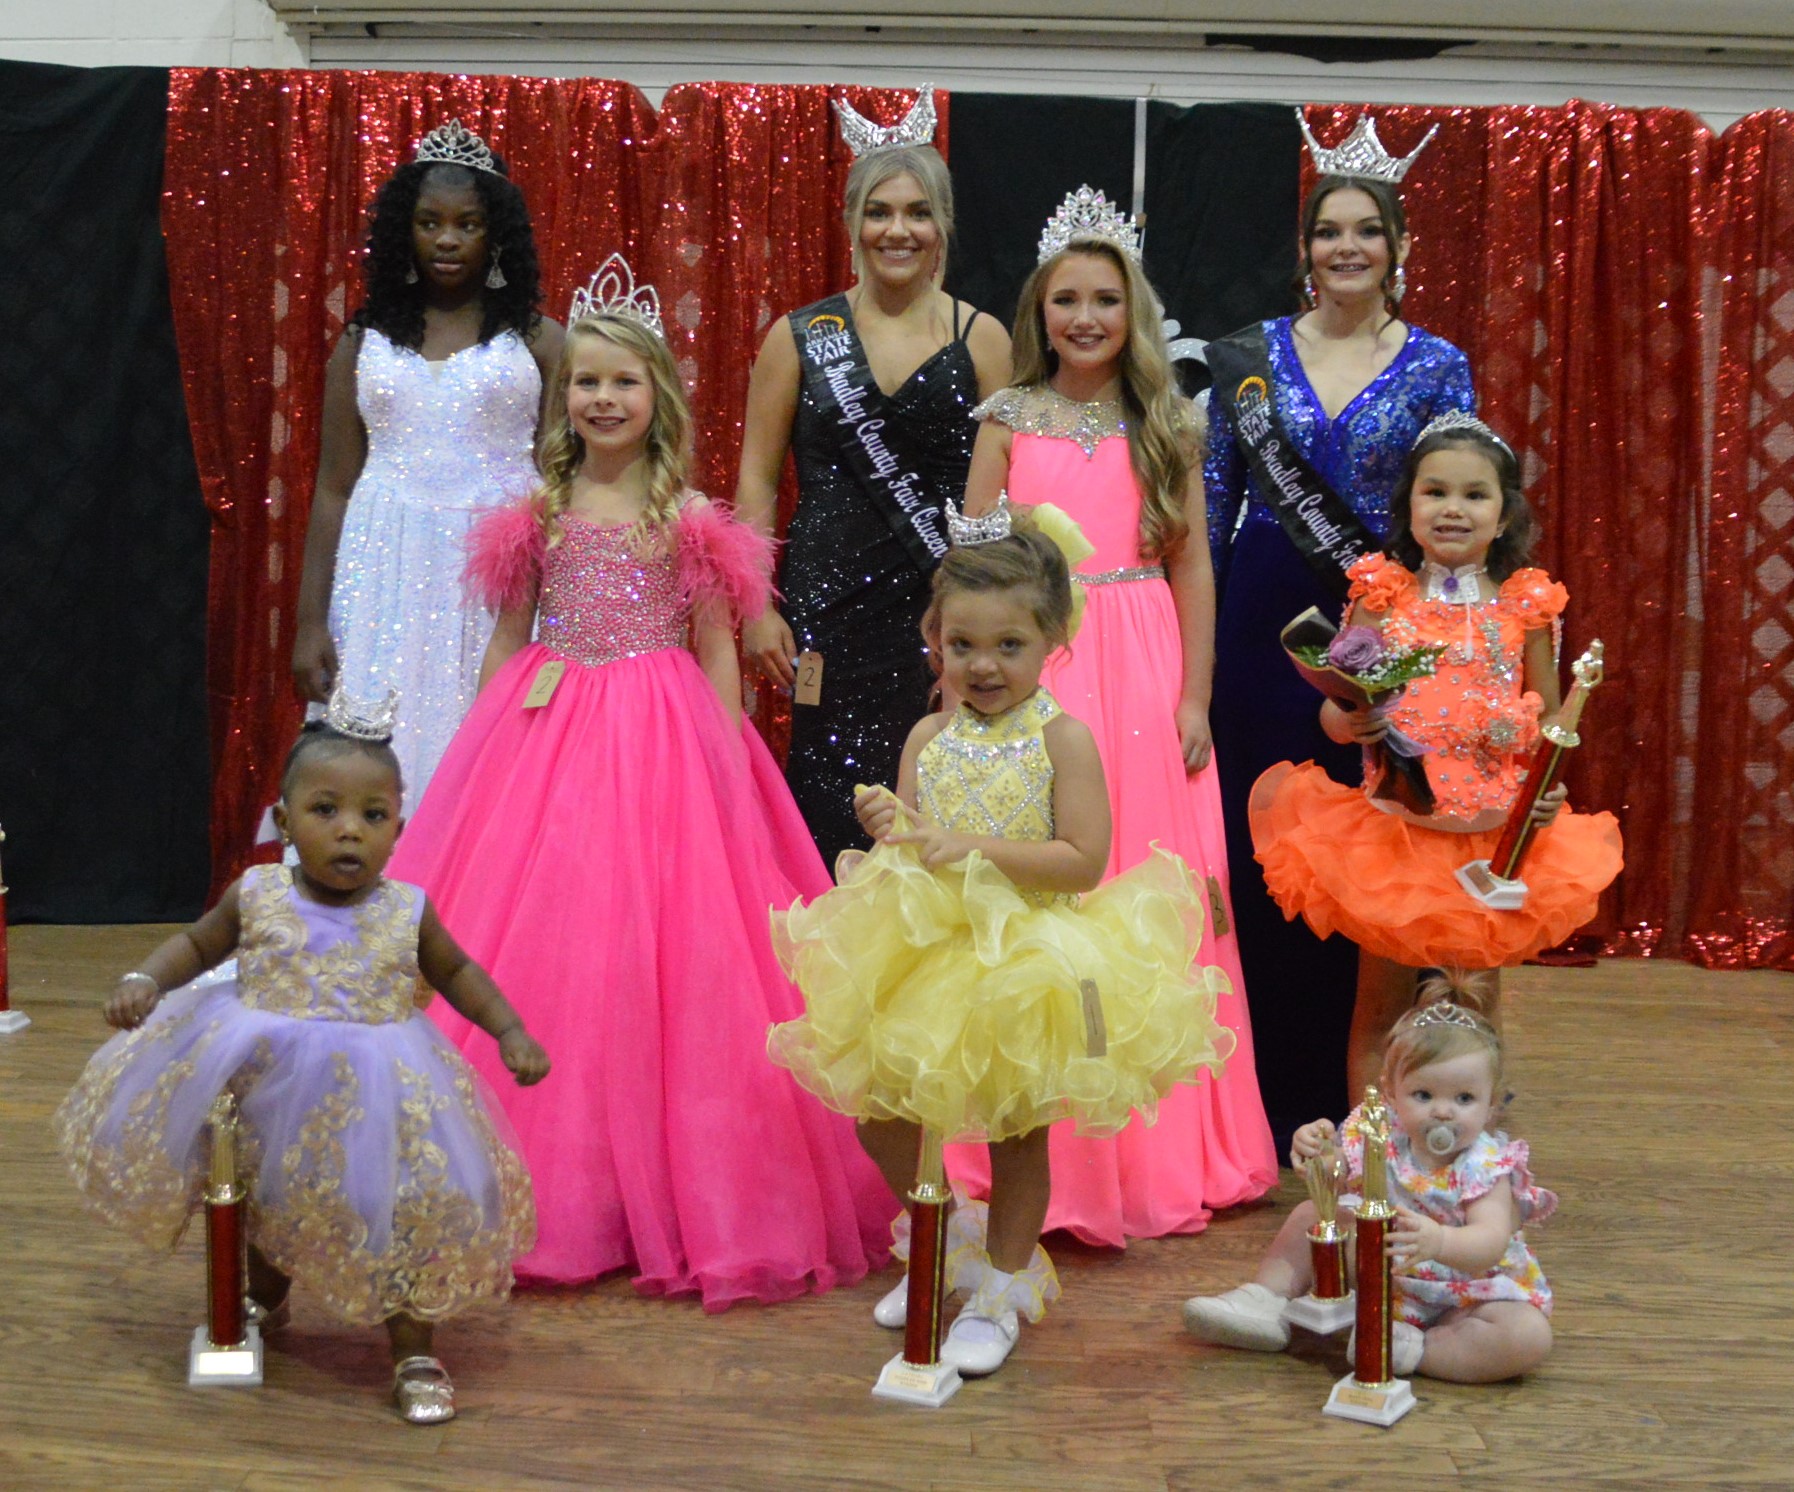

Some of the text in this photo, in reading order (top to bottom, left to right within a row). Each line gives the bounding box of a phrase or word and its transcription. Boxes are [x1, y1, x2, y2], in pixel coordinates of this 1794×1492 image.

[806, 335, 852, 358] STATE
[814, 345, 851, 365] FAIR
[1240, 404, 1271, 439] STATE
[1247, 419, 1273, 447] FAIR
[824, 360, 949, 559] Bradley County Fair Queen
[1259, 439, 1304, 506] Bradley
[1297, 493, 1342, 553] County
[535, 675, 553, 695] 2
[804, 666, 815, 687] 2
